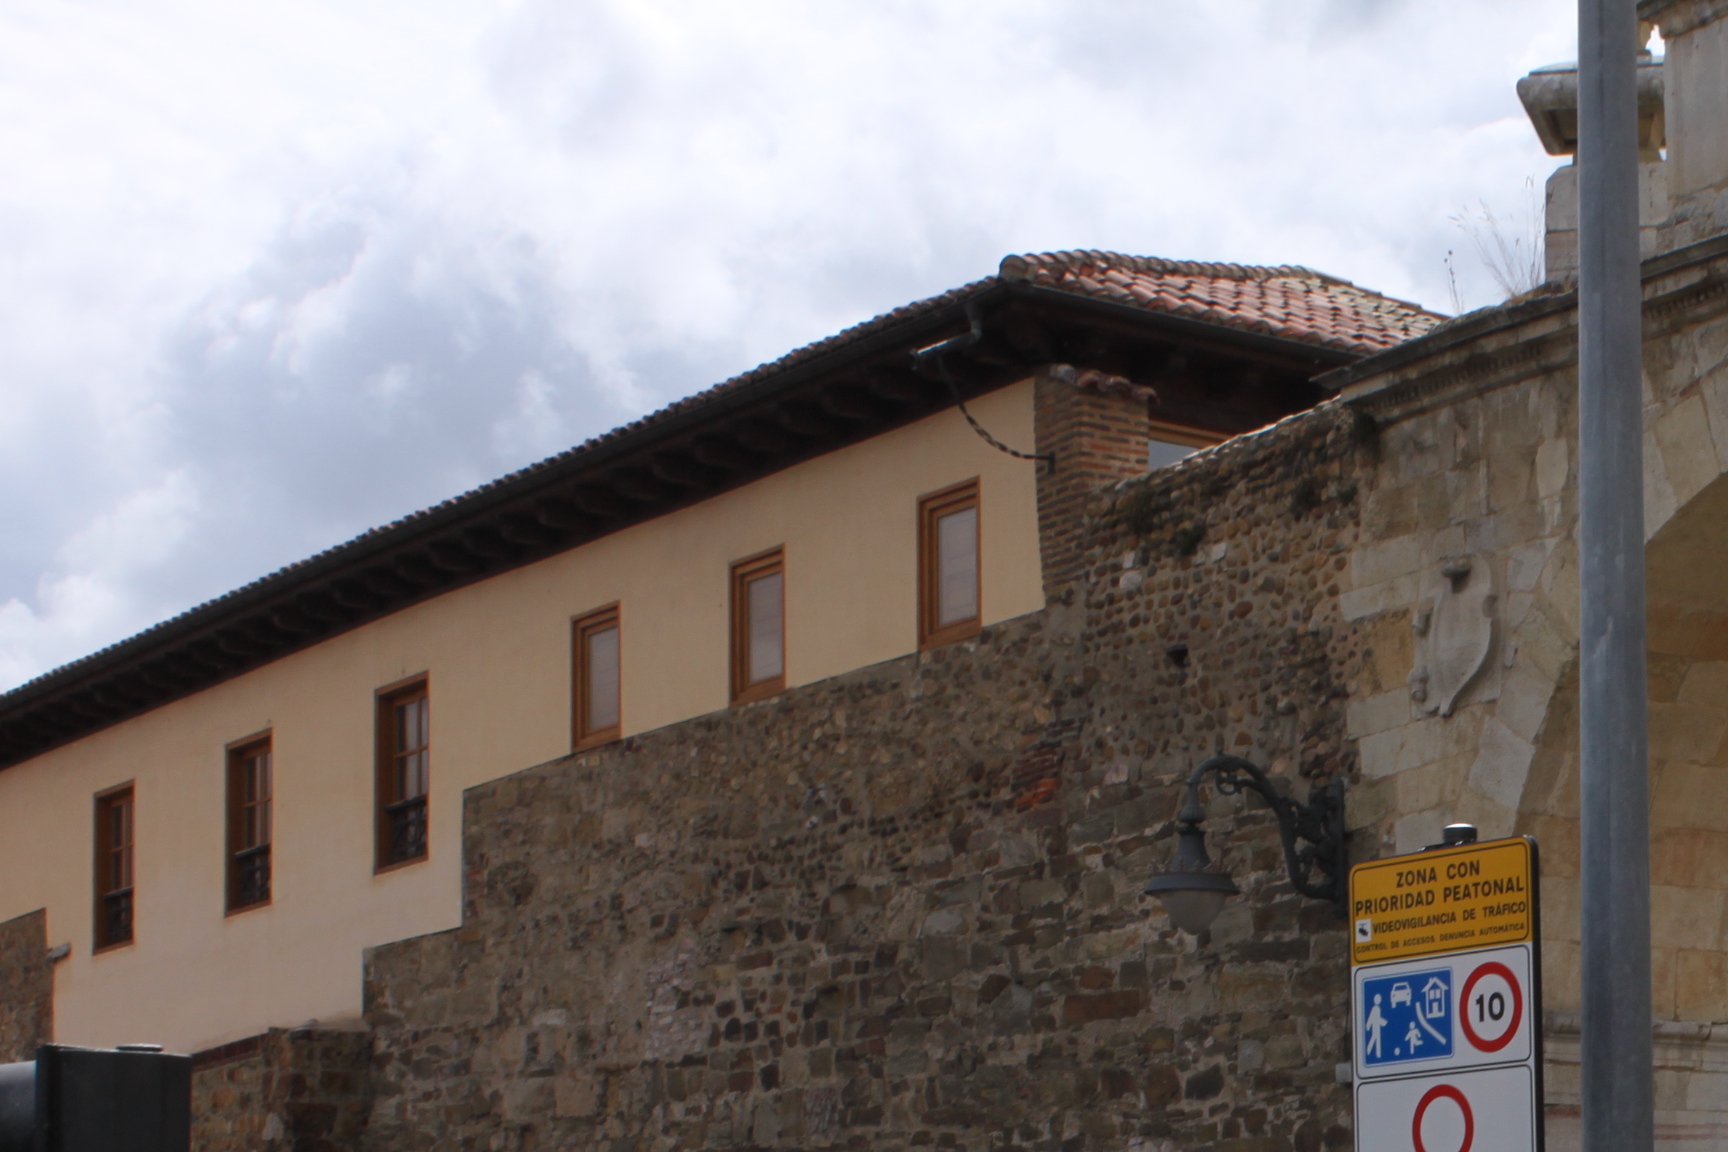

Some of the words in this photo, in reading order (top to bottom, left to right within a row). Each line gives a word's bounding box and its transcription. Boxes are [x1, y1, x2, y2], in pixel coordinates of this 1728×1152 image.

[1396, 866, 1438, 888] ZONA
[1446, 860, 1481, 880] CON
[1355, 890, 1435, 916] PRIORIDAD
[1443, 876, 1524, 903] PEATONAL
[1373, 912, 1457, 934] VIDEOVIGILANCIA
[1462, 908, 1476, 921] DE
[1482, 901, 1526, 918] TRÁFICO
[1356, 943, 1388, 954] CONTROL
[1390, 940, 1400, 948] DE
[1440, 930, 1476, 942] DENUNCIA
[1475, 992, 1505, 1023] 10
